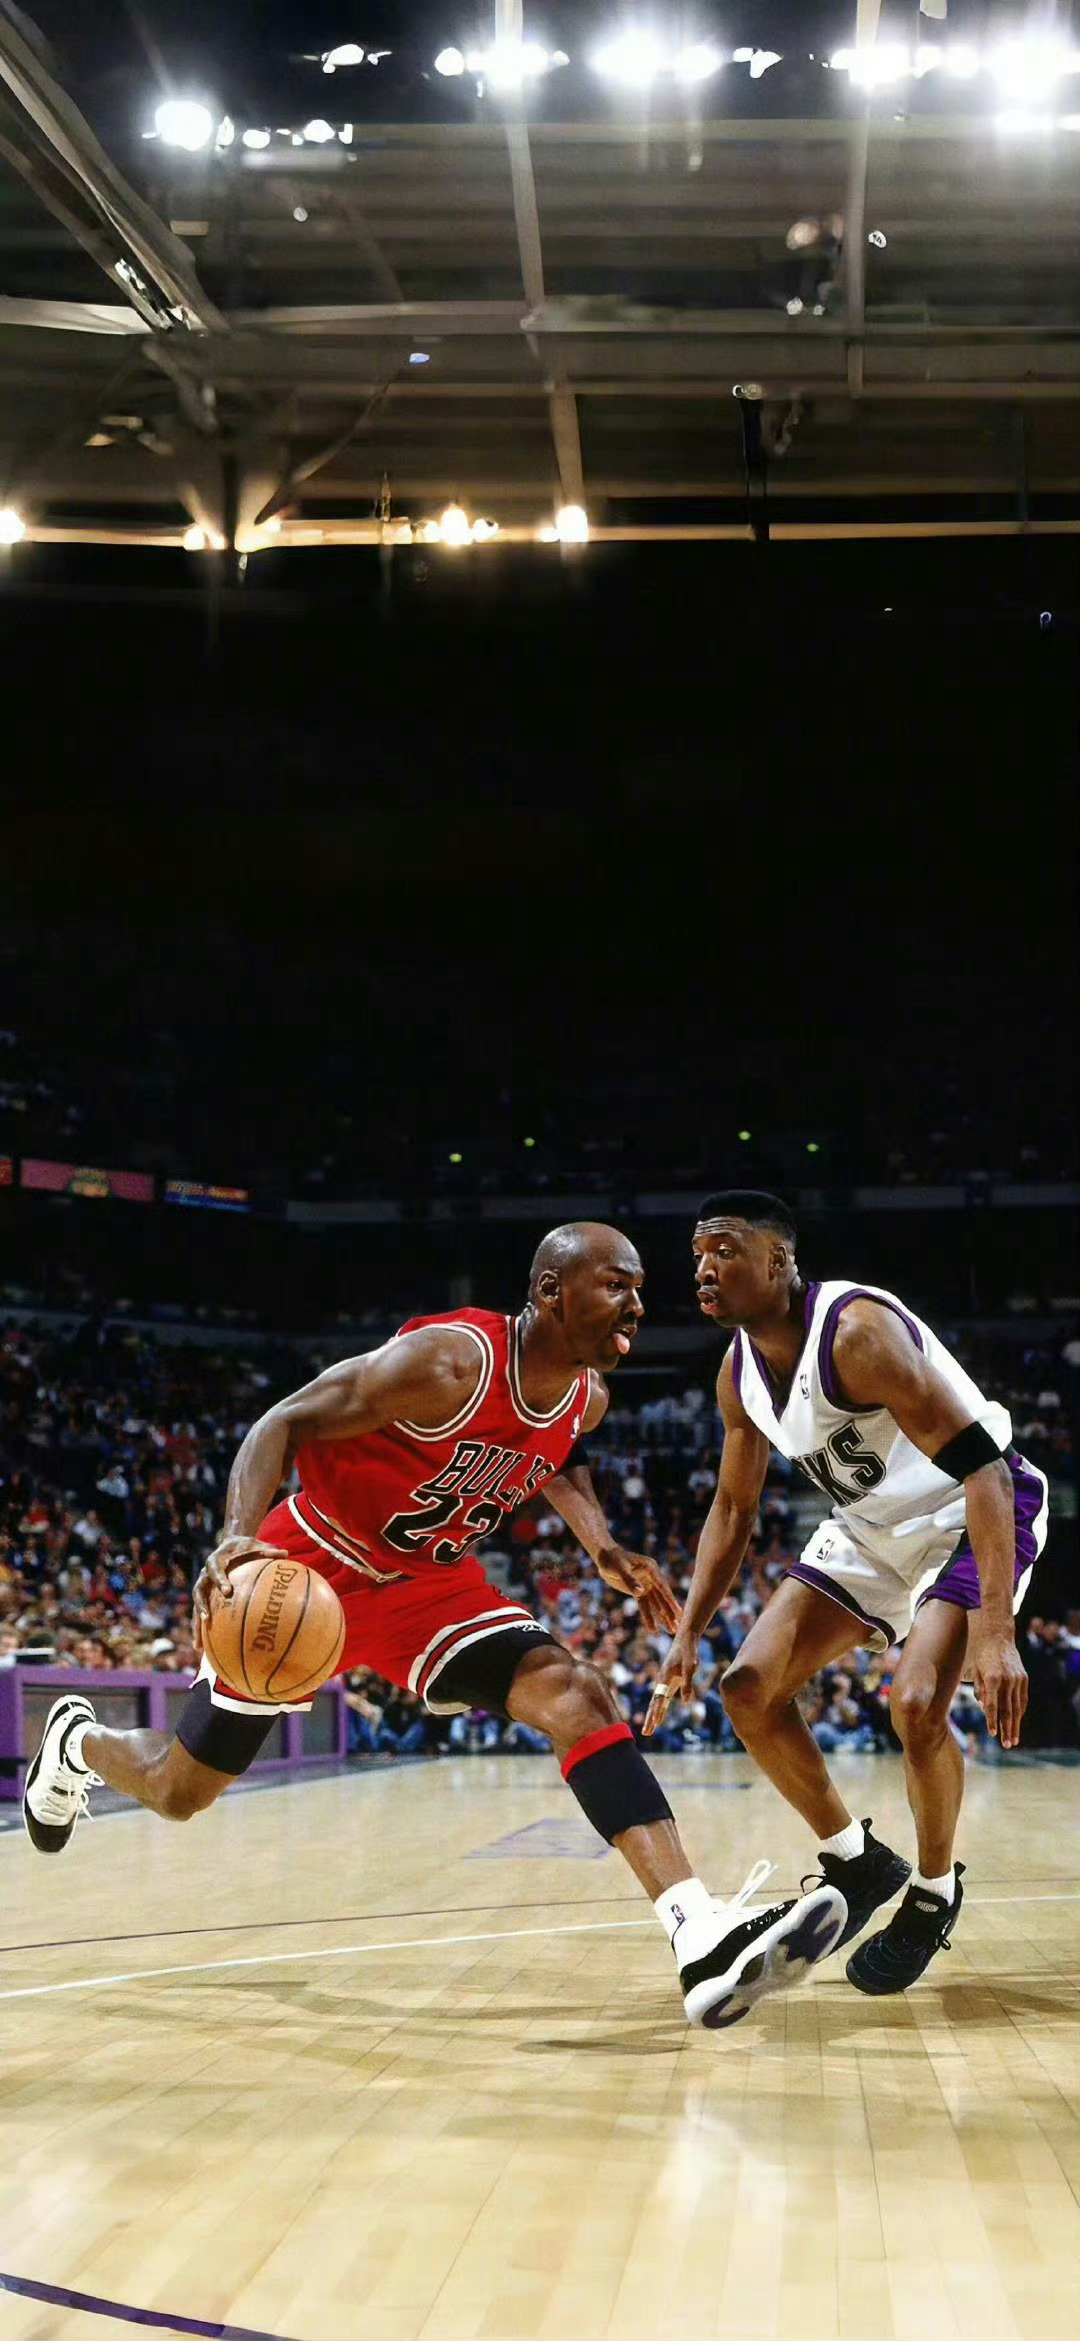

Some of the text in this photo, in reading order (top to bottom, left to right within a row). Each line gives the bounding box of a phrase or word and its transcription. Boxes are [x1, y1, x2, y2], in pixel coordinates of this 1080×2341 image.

[789, 1419, 886, 1508] KS
[380, 1489, 503, 1564] 23
[253, 1563, 299, 1652] SPALDING
